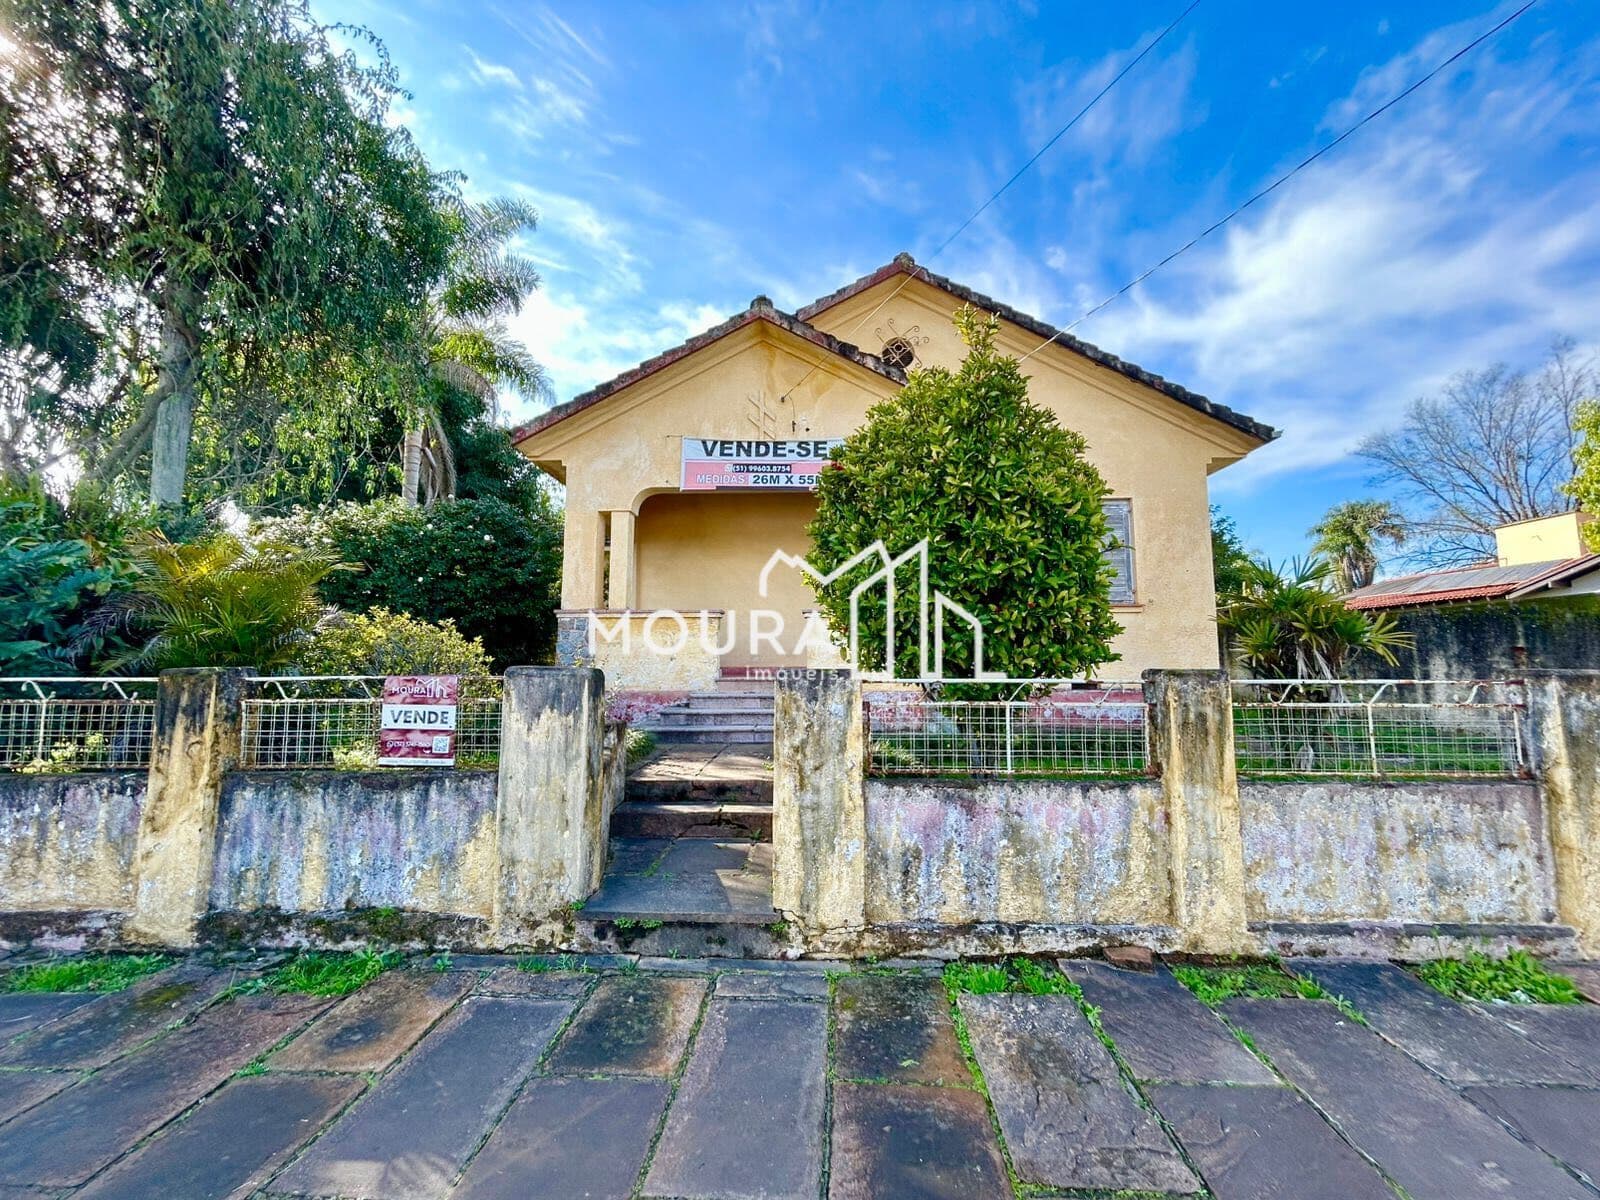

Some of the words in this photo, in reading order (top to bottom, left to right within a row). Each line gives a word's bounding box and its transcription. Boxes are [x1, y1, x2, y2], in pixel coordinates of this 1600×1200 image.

[701, 440, 828, 457] VENDE-SE
[752, 475, 780, 484] 26M
[785, 475, 794, 484] X
[392, 686, 427, 694] MOURA
[390, 710, 449, 724] VENDE
